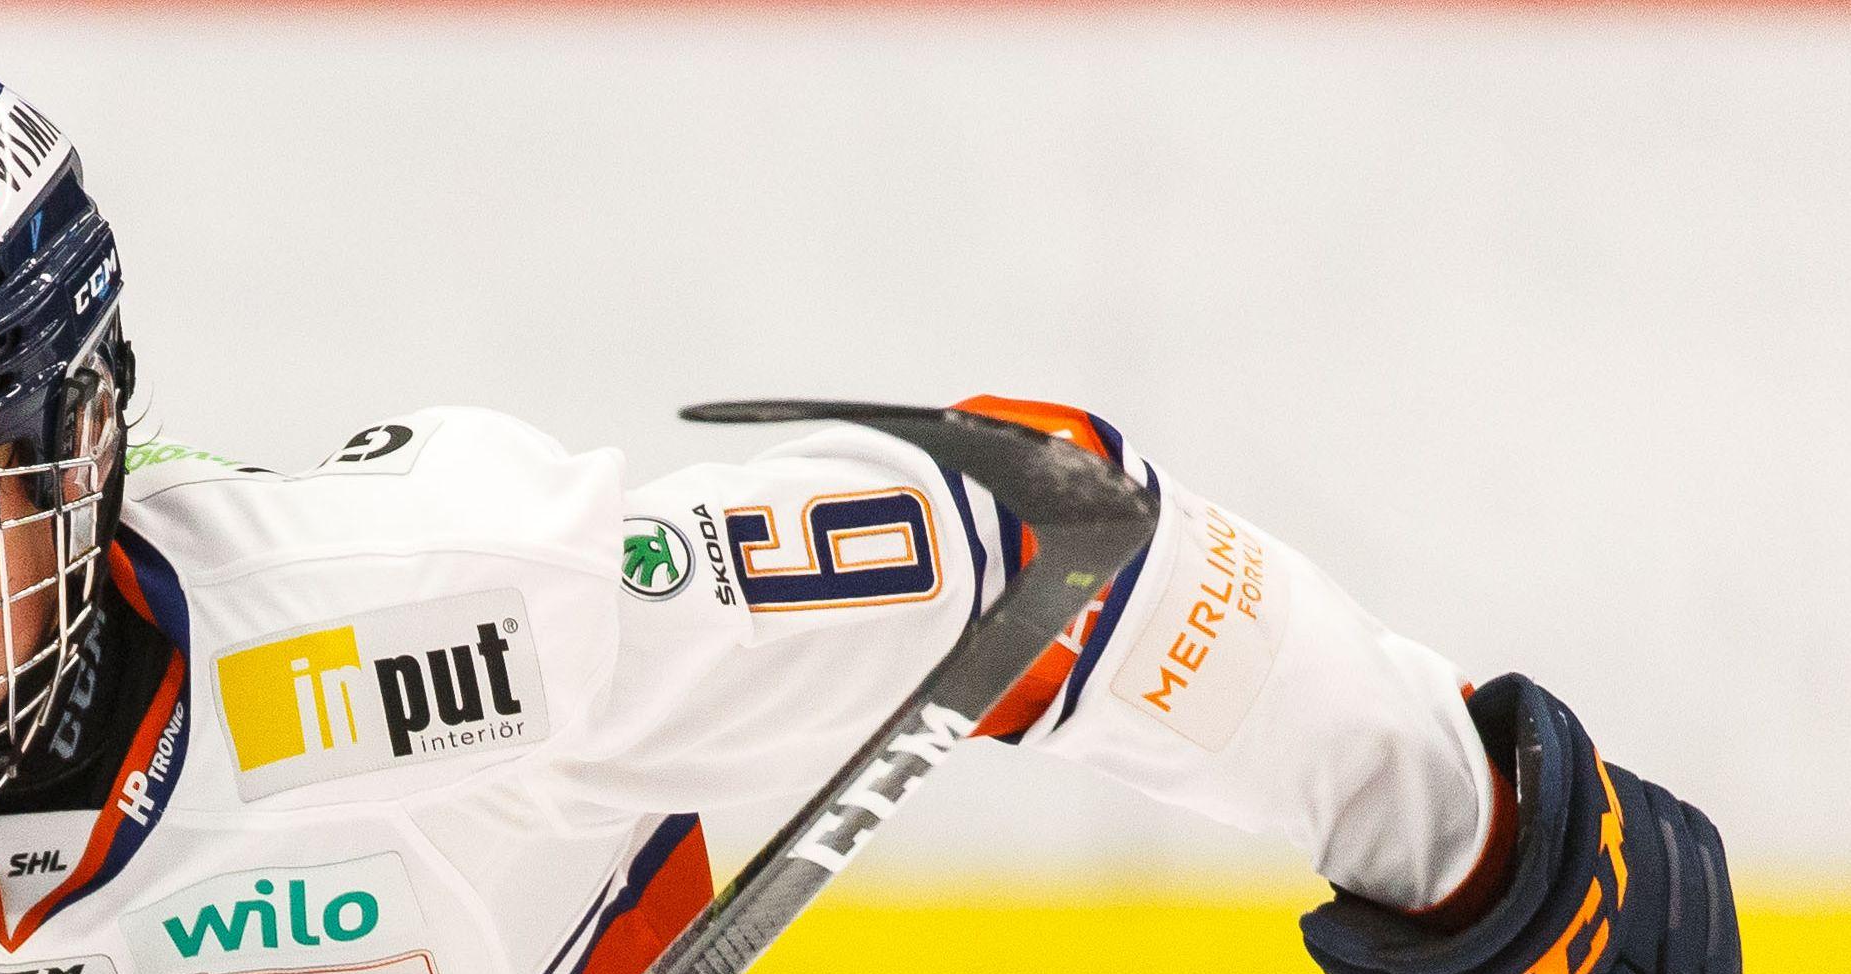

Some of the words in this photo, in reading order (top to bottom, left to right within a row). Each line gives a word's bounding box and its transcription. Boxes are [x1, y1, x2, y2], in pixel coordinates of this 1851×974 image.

[74, 247, 118, 315] CCM
[692, 503, 736, 606] ŠKODA
[724, 486, 942, 613] 6
[1238, 535, 1263, 620] FORKL
[1141, 506, 1236, 712] MERLINU
[420, 718, 525, 755] interiör
[116, 770, 155, 828] HP
[788, 701, 979, 874] CCM
[8, 850, 67, 877] SHL
[162, 878, 379, 958] wilo
